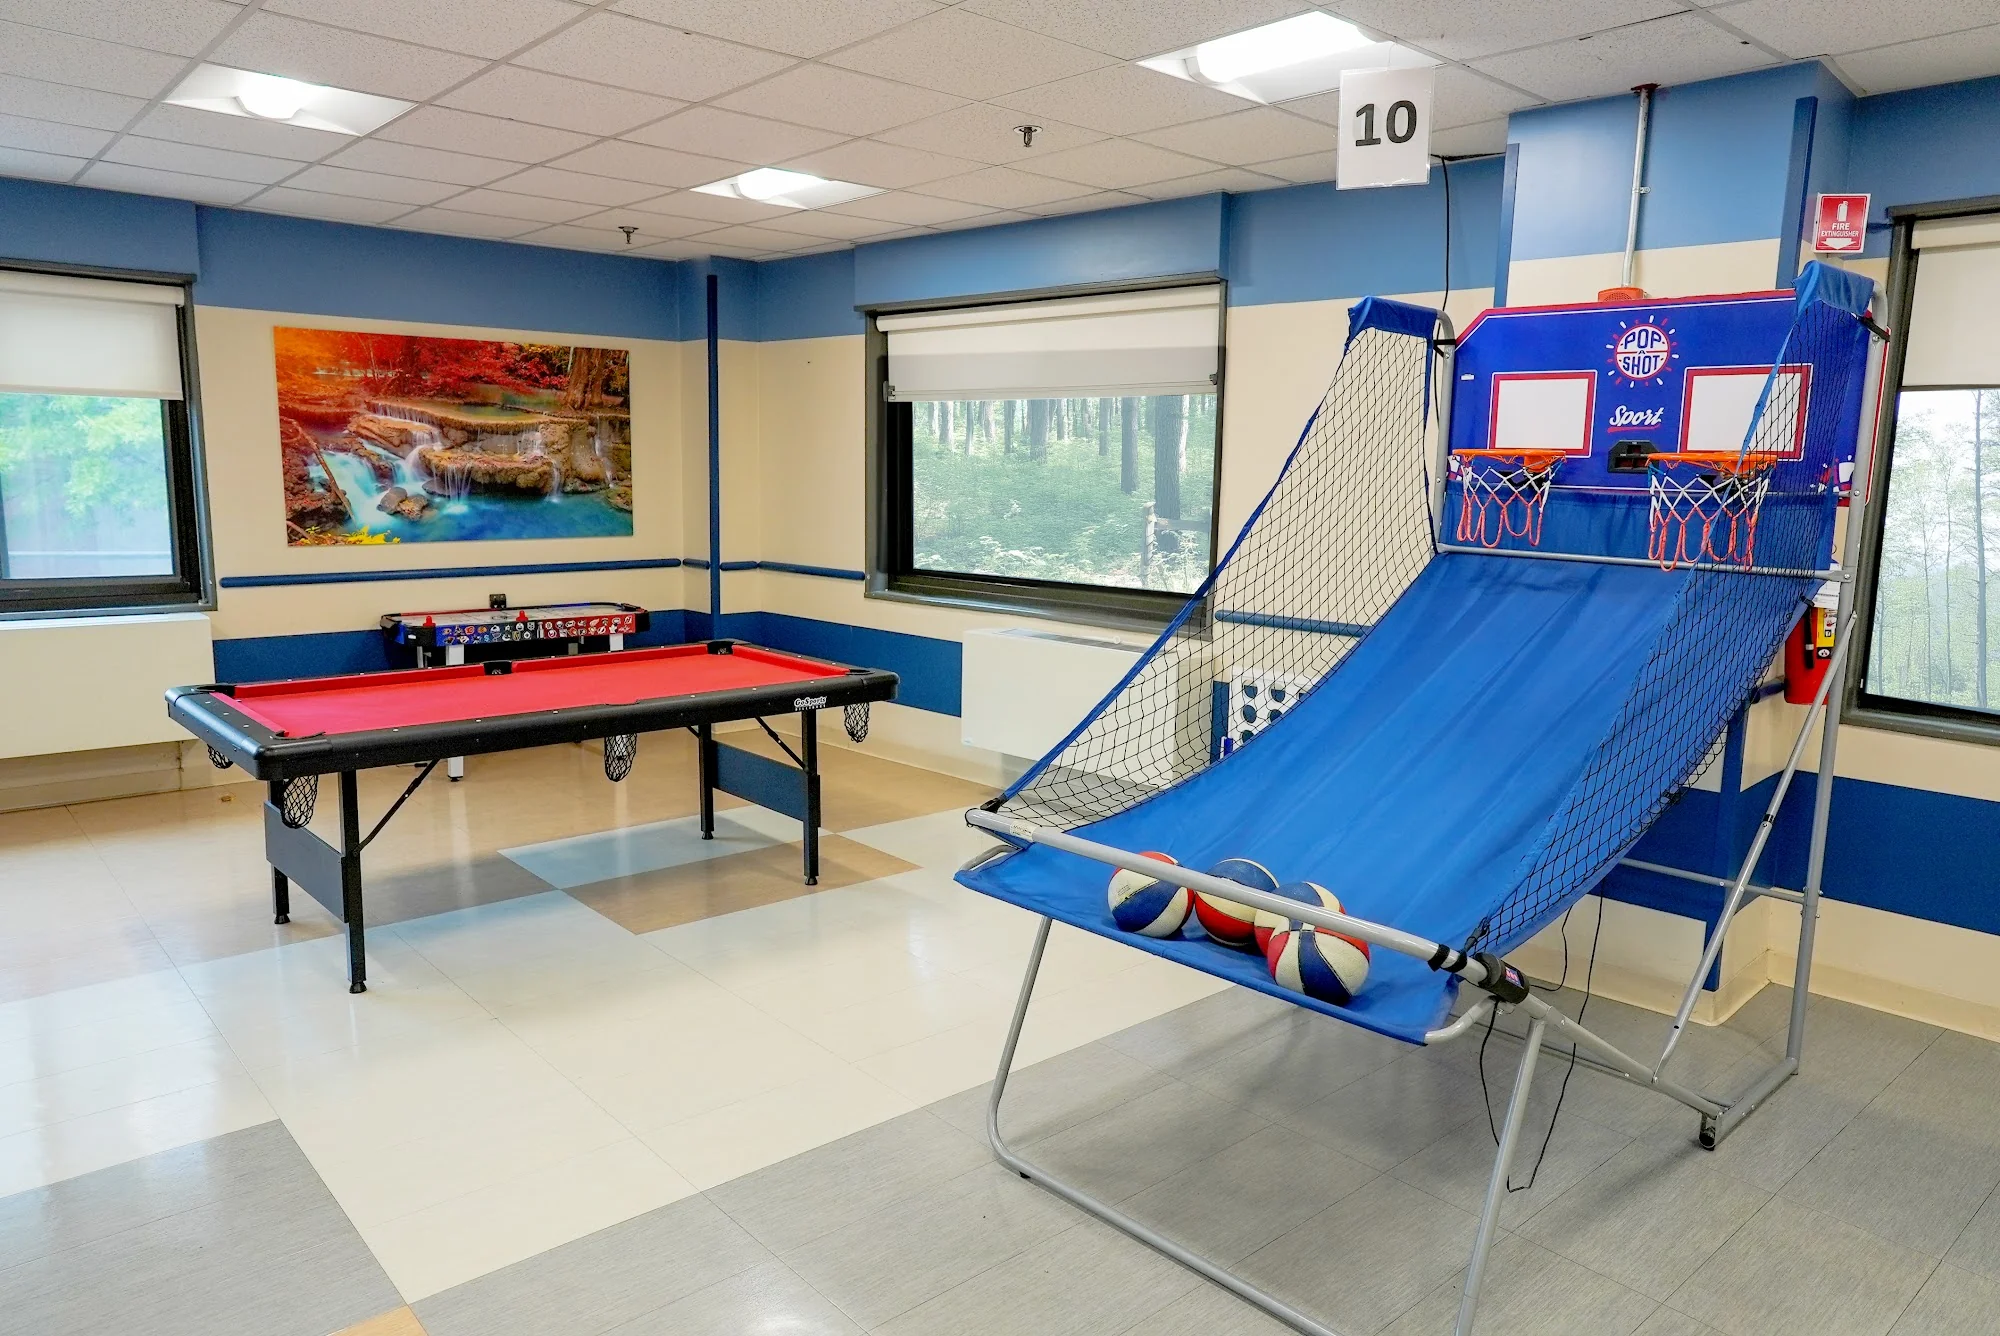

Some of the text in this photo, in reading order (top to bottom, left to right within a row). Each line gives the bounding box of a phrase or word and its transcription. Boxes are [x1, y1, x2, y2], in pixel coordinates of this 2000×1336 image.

[1355, 99, 1418, 147] 10
[1820, 230, 1860, 238] EXTINGUISHER
[1831, 222, 1851, 231] FIRE
[1624, 328, 1662, 350] POP
[1622, 354, 1661, 376] SHOT
[1609, 404, 1664, 427] Sport
[793, 696, 828, 708] GoSports
